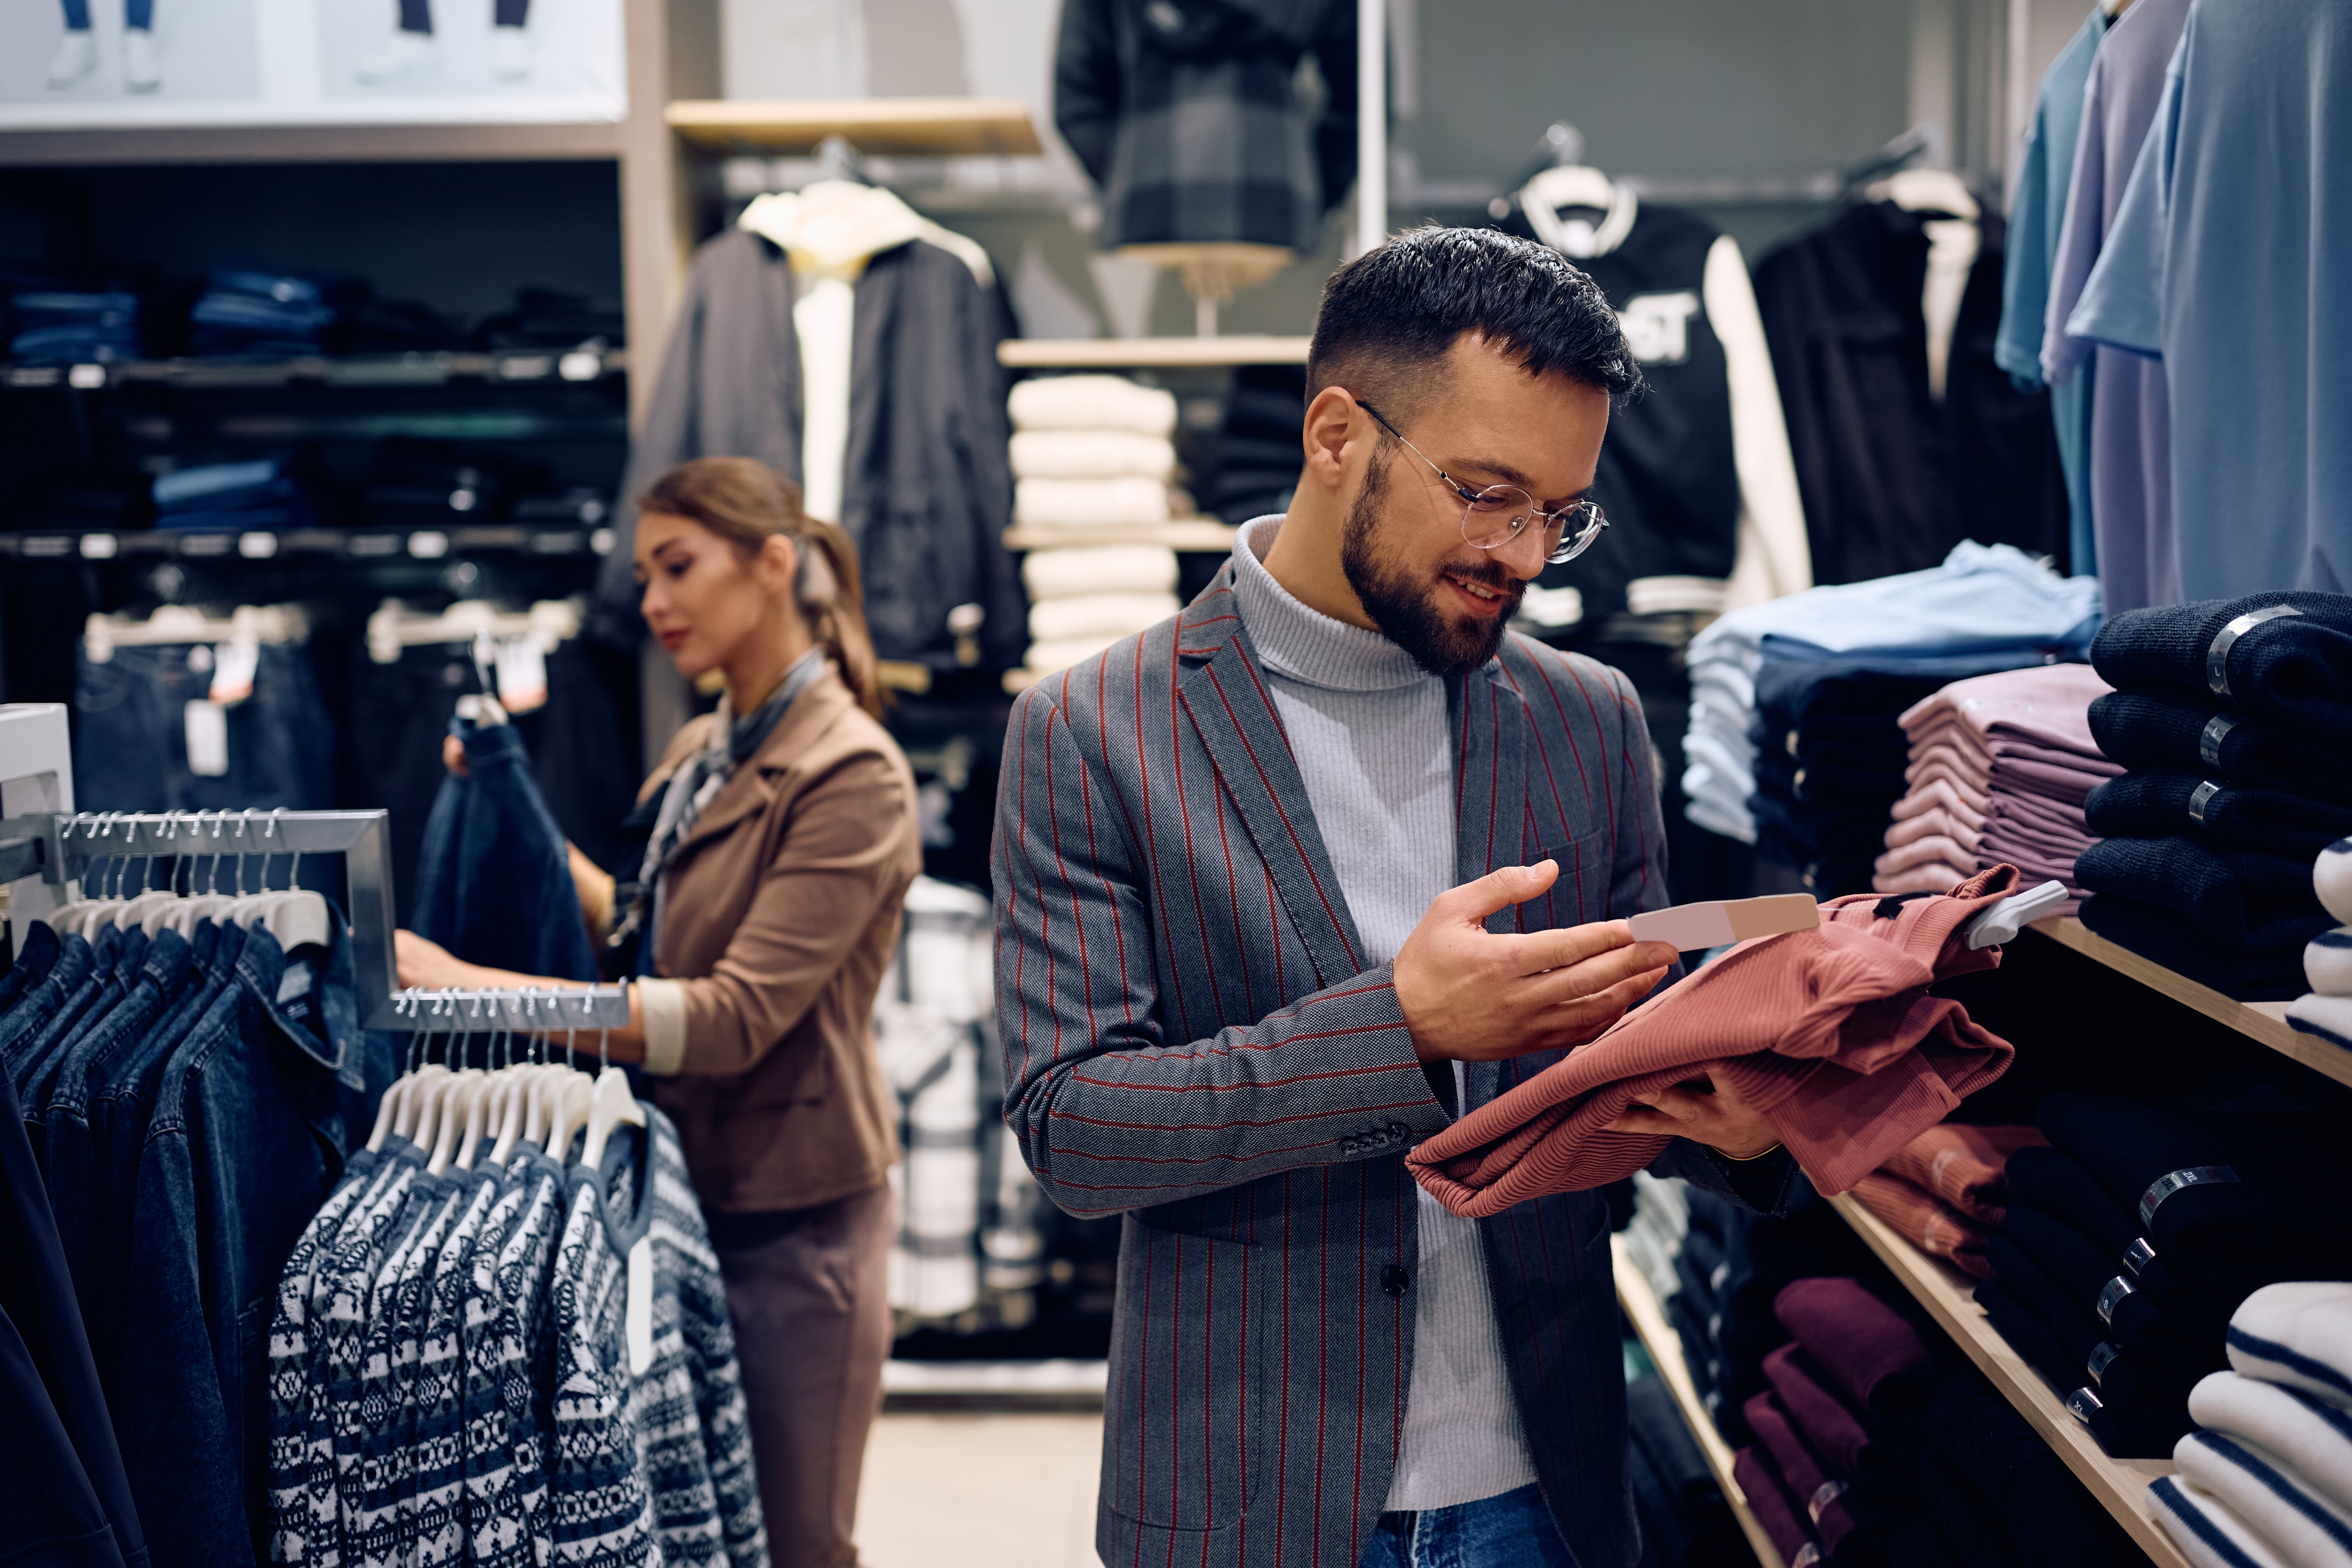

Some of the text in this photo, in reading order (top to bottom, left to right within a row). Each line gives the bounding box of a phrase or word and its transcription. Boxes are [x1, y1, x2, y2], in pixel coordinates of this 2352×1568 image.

[1616, 293, 1698, 361] ST
[2215, 666, 2220, 677] L
[2211, 727, 2218, 737] L
[2182, 1171, 2198, 1183] 2XL
[2161, 1178, 2175, 1191] 2XL
[2103, 1299, 2109, 1309] S
